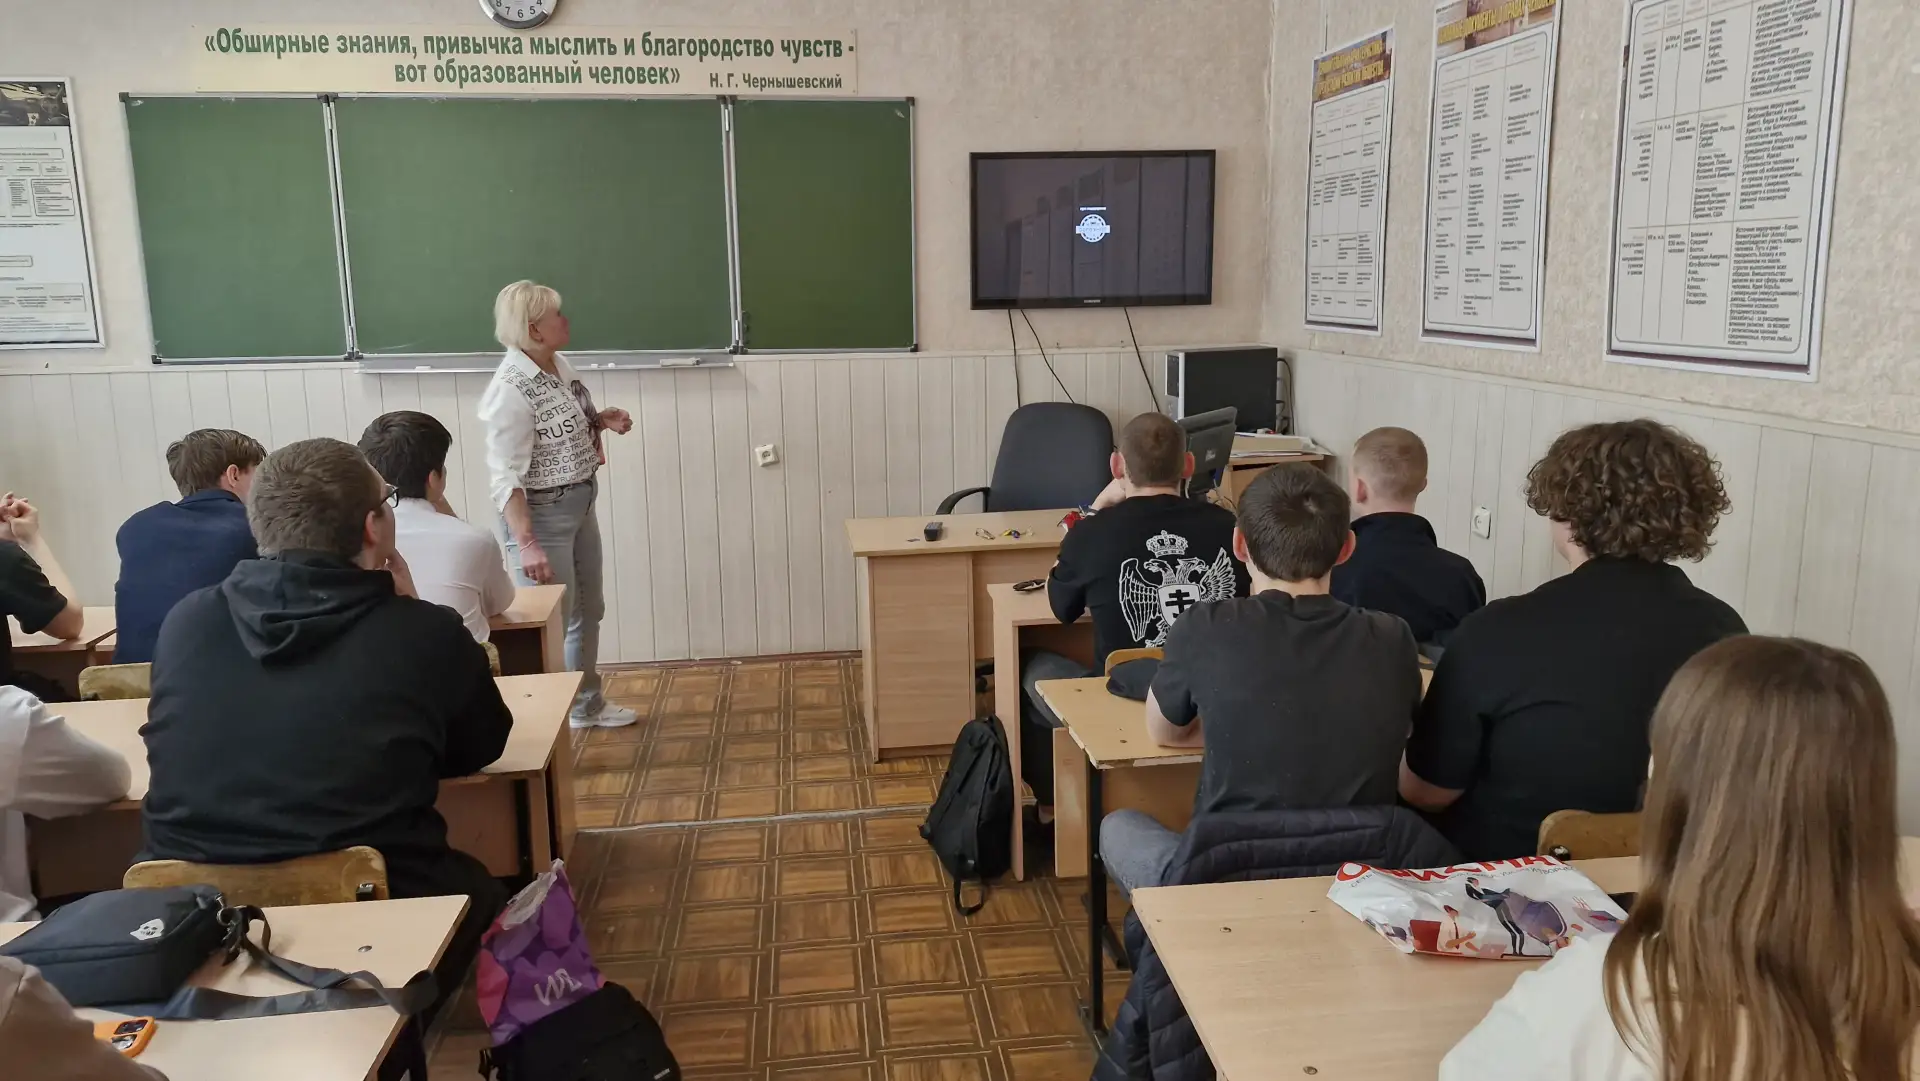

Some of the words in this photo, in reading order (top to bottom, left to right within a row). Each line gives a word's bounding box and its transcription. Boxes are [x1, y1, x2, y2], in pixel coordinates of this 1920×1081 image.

[505, 6, 511, 15] 7
[517, 9, 524, 18] 6
[529, 6, 536, 14] 5
[204, 28, 330, 60] «Обширные
[336, 34, 418, 60] знания,
[424, 35, 524, 60] привычка
[530, 37, 617, 56] мыслить
[624, 38, 636, 56] и
[641, 32, 774, 62] благородство
[780, 39, 843, 64] чувств
[394, 64, 427, 82] вот
[434, 58, 582, 88] образованный
[588, 66, 680, 85] человек»
[709, 72, 723, 88] Н.
[726, 72, 738, 88] Г.
[742, 74, 842, 92] Чернышевский
